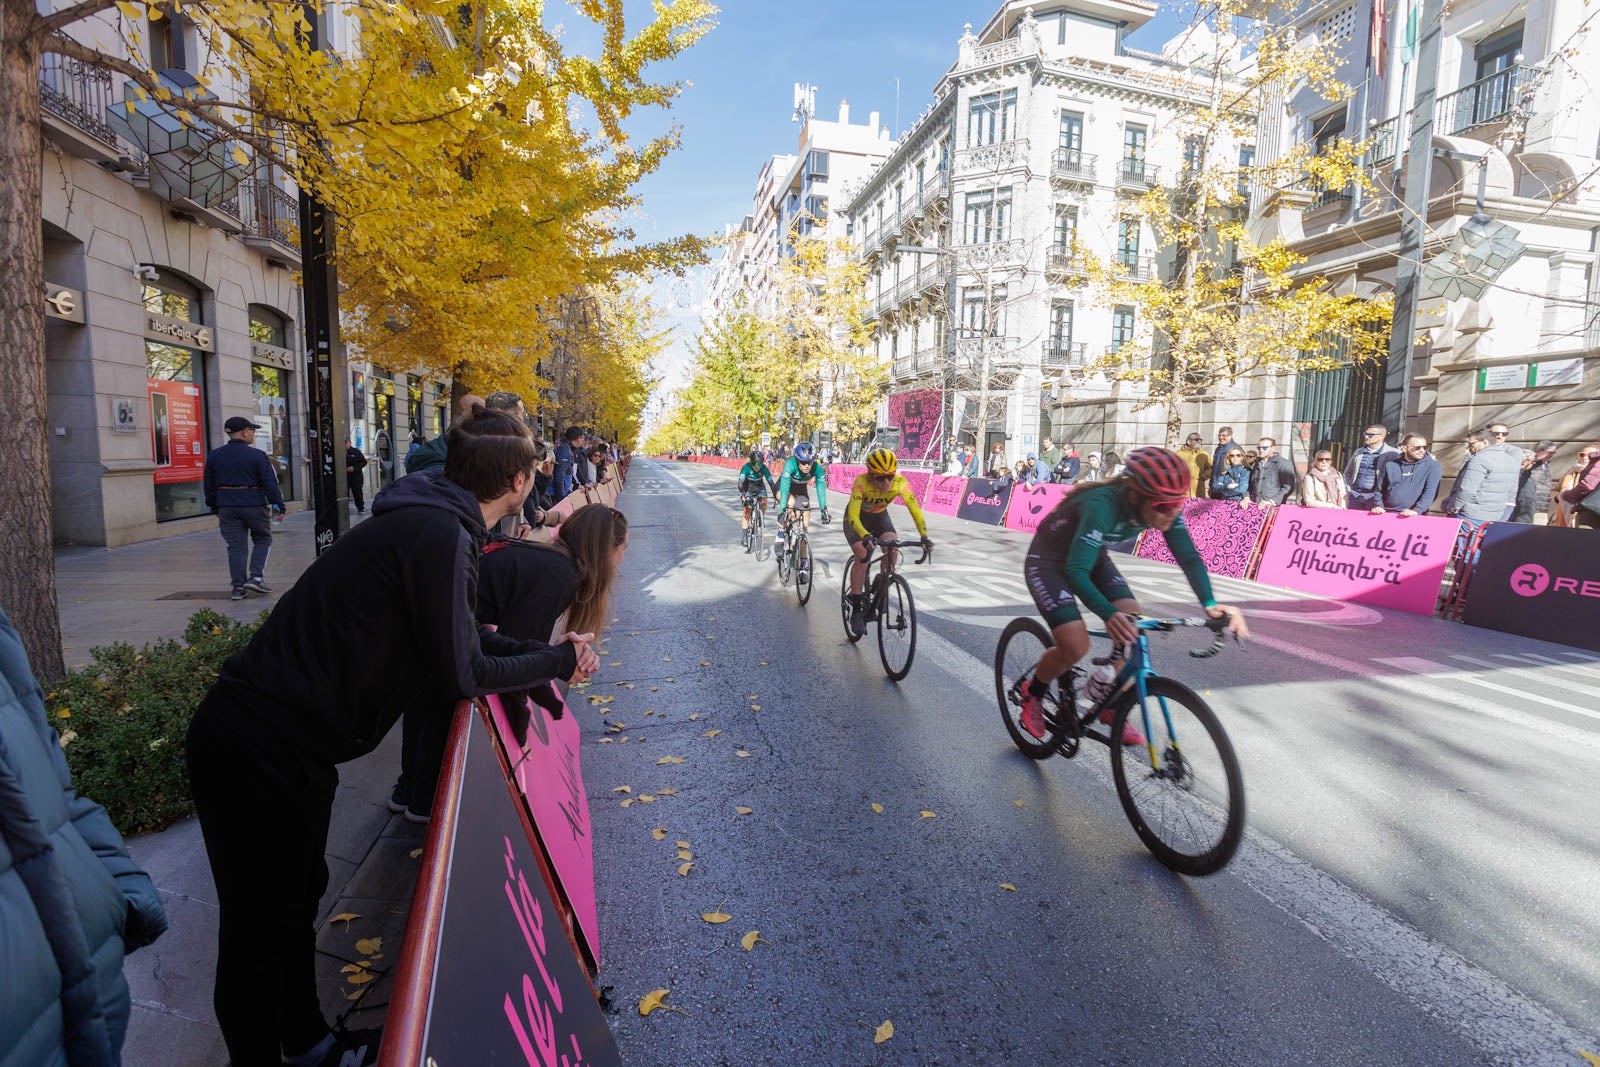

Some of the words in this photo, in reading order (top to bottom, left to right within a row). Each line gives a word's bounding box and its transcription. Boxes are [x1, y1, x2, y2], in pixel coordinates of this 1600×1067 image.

[974, 495, 1002, 507] RELEVO
[1287, 520, 1360, 548] Reinäs
[1366, 530, 1397, 553] de
